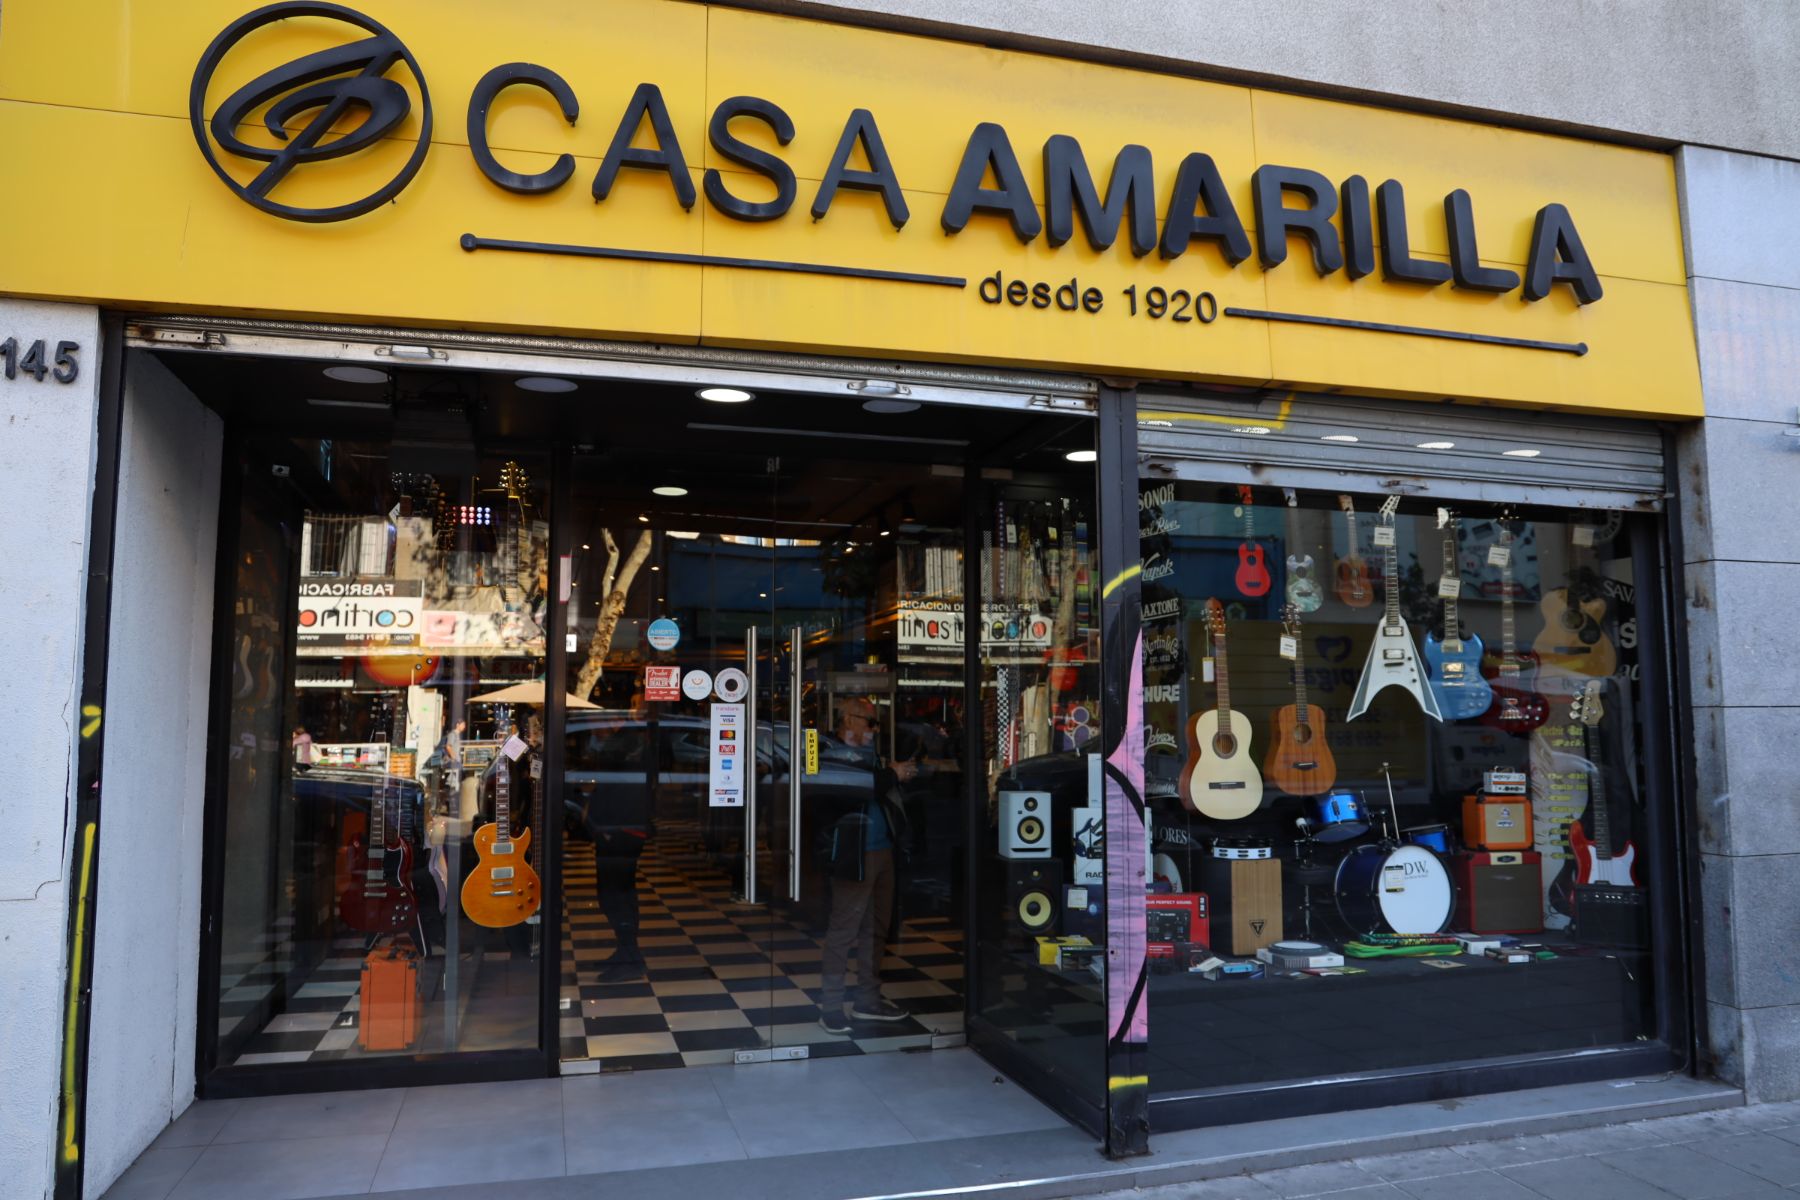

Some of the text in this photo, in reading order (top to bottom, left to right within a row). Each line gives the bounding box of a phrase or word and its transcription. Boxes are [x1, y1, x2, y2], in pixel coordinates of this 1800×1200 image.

[467, 62, 1604, 307] CASA AMARILLA
[979, 270, 1218, 325] desde 1920
[0, 337, 80, 385] 145
[1138, 482, 1176, 511] SONOR
[1602, 579, 1635, 605] SAV
[897, 600, 952, 612] RICACION
[1141, 597, 1180, 620] AXTONE
[1143, 684, 1181, 703] HURE
